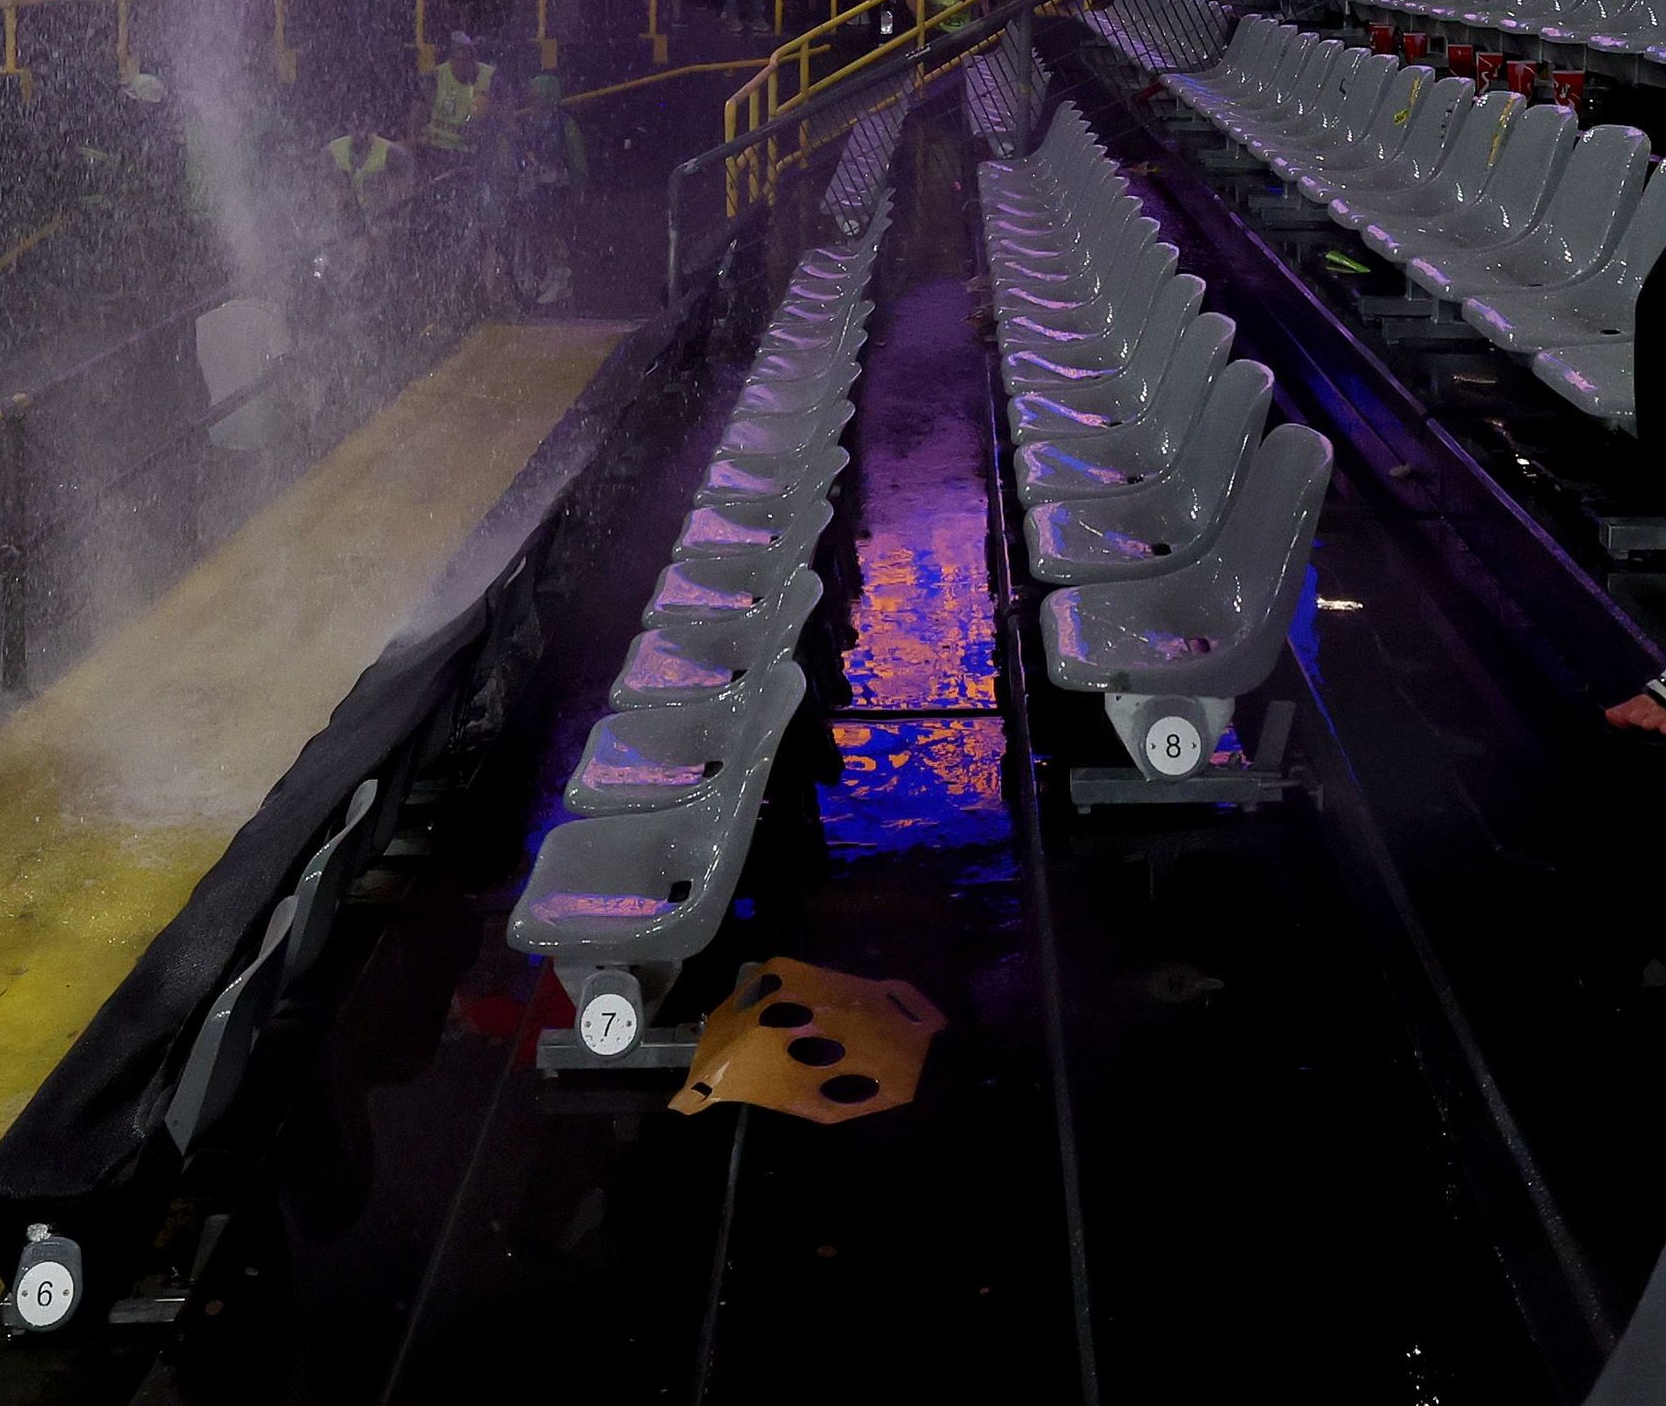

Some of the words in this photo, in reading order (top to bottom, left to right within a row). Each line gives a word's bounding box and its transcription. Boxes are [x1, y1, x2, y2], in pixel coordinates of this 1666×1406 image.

[1165, 733, 1182, 759] 8
[600, 1012, 617, 1037] 7
[36, 1281, 54, 1307] 6
